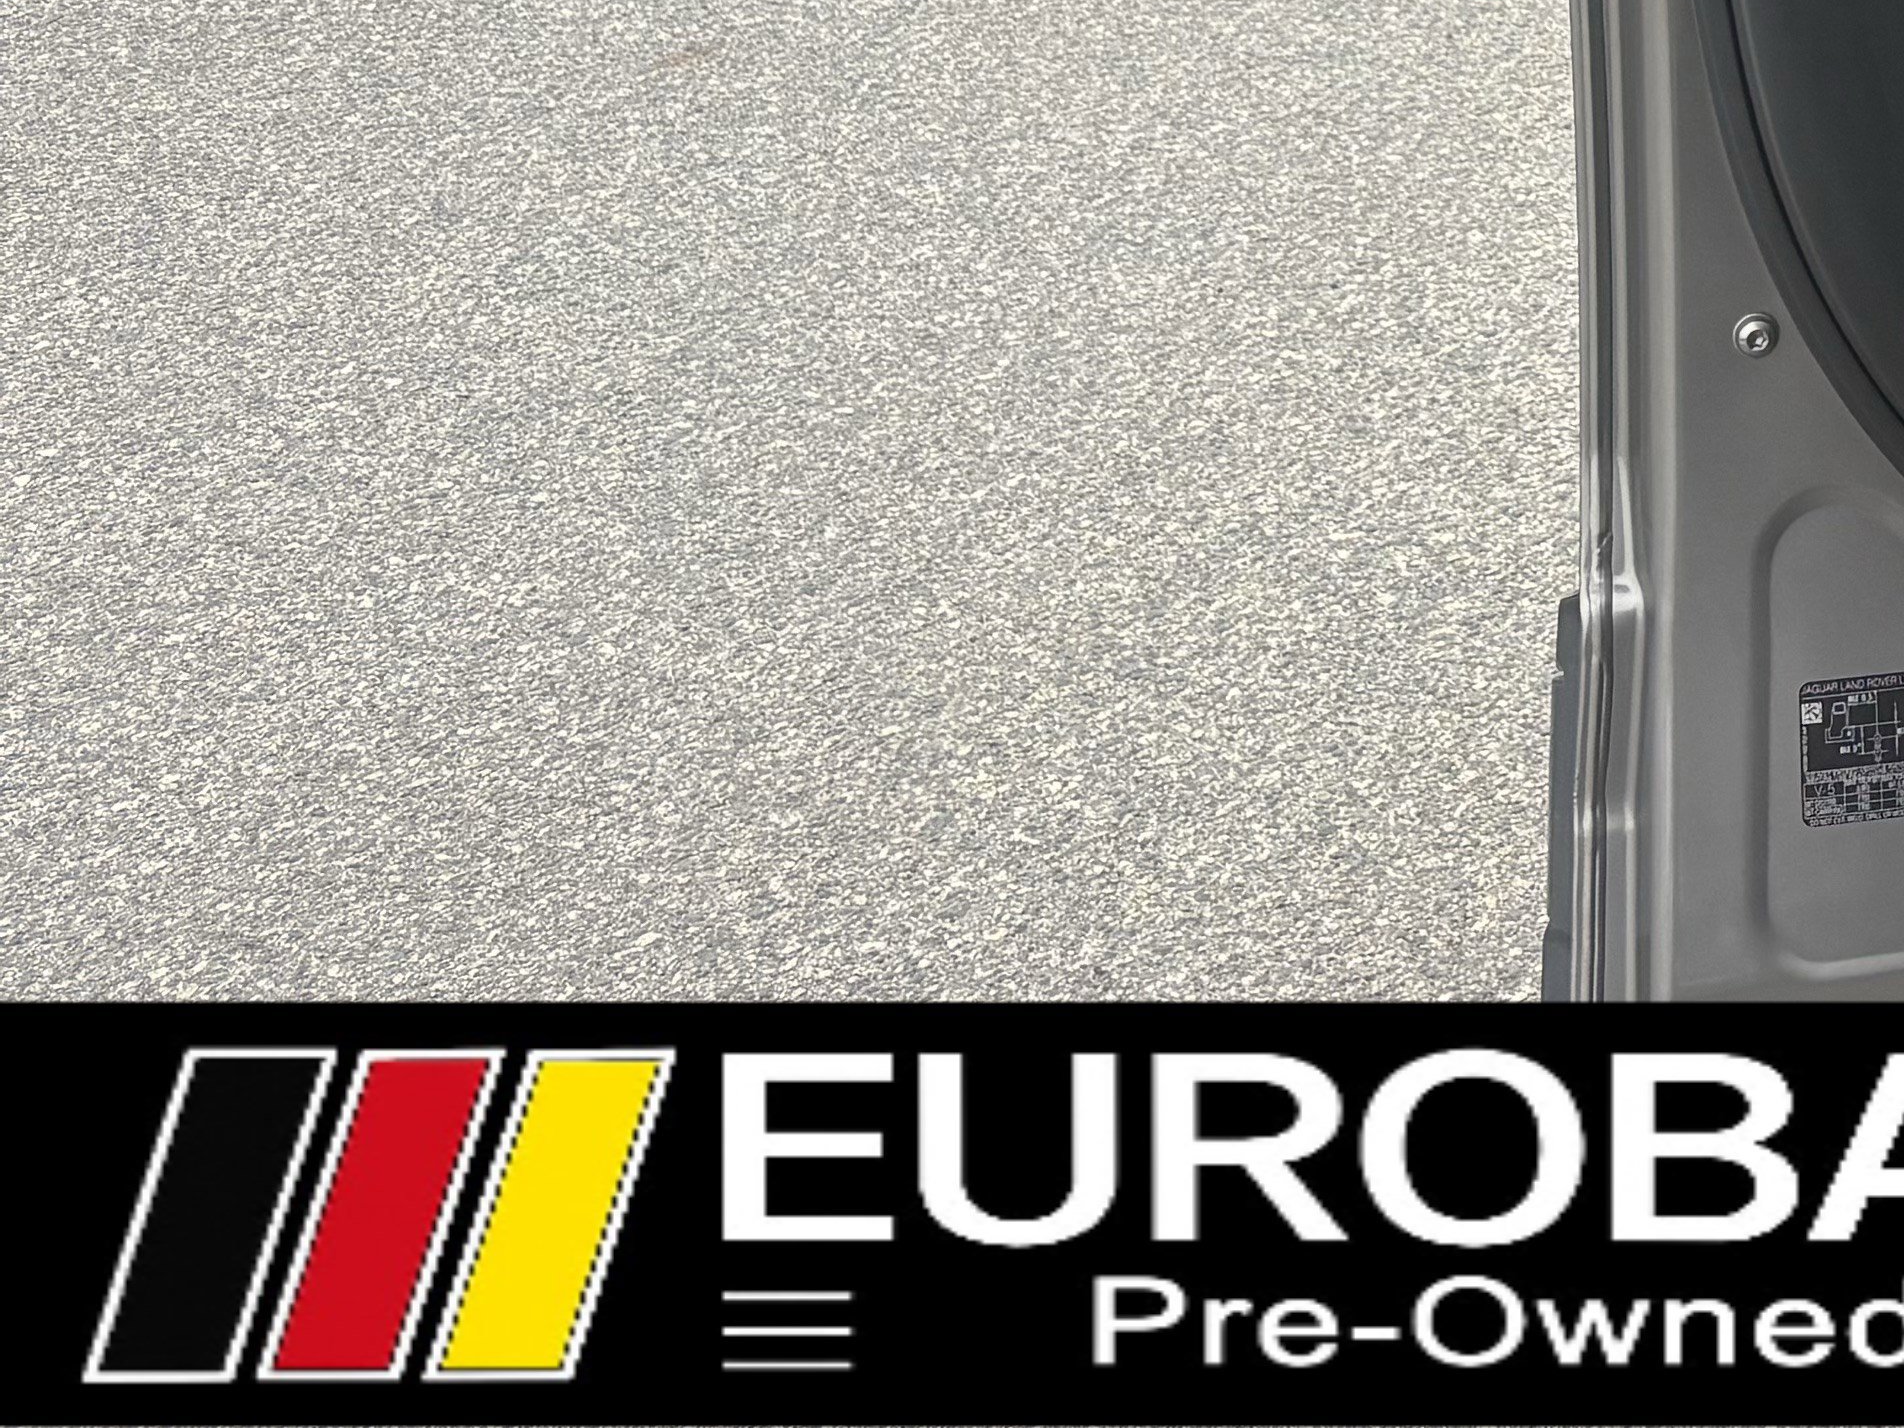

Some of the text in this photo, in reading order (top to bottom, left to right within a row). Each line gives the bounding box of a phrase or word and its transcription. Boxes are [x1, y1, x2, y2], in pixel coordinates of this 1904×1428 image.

[1802, 683, 1838, 694] JAGUAR
[1840, 679, 1864, 691] LAND
[1867, 675, 1897, 688] ROVER
